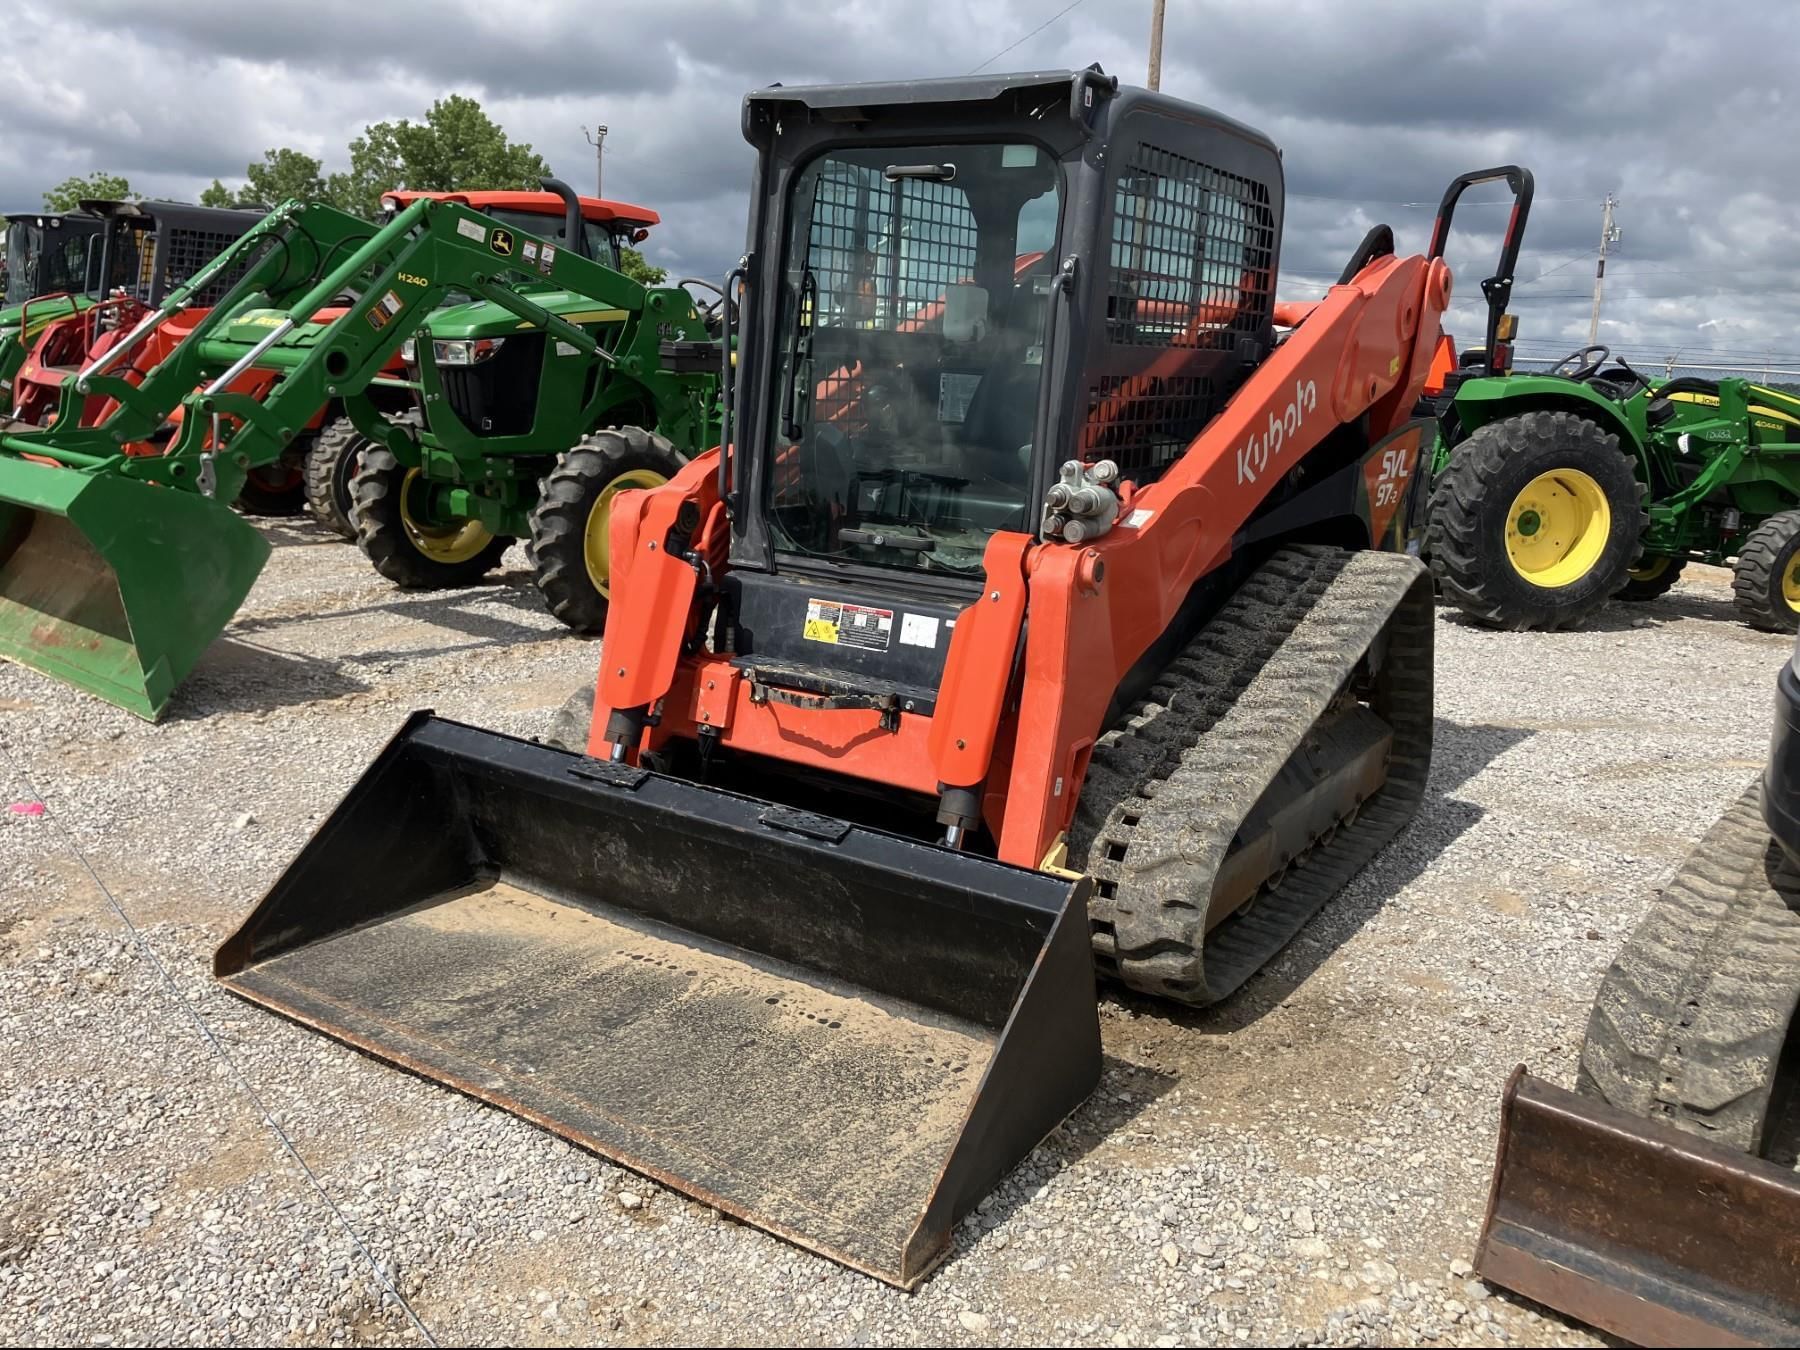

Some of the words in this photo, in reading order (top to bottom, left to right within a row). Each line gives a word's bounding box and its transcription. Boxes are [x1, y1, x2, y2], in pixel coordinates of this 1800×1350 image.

[398, 272, 428, 287] H240
[1237, 379, 1316, 486] Kubota
[1378, 449, 1408, 481] SVL
[1375, 483, 1398, 507] 97-2
